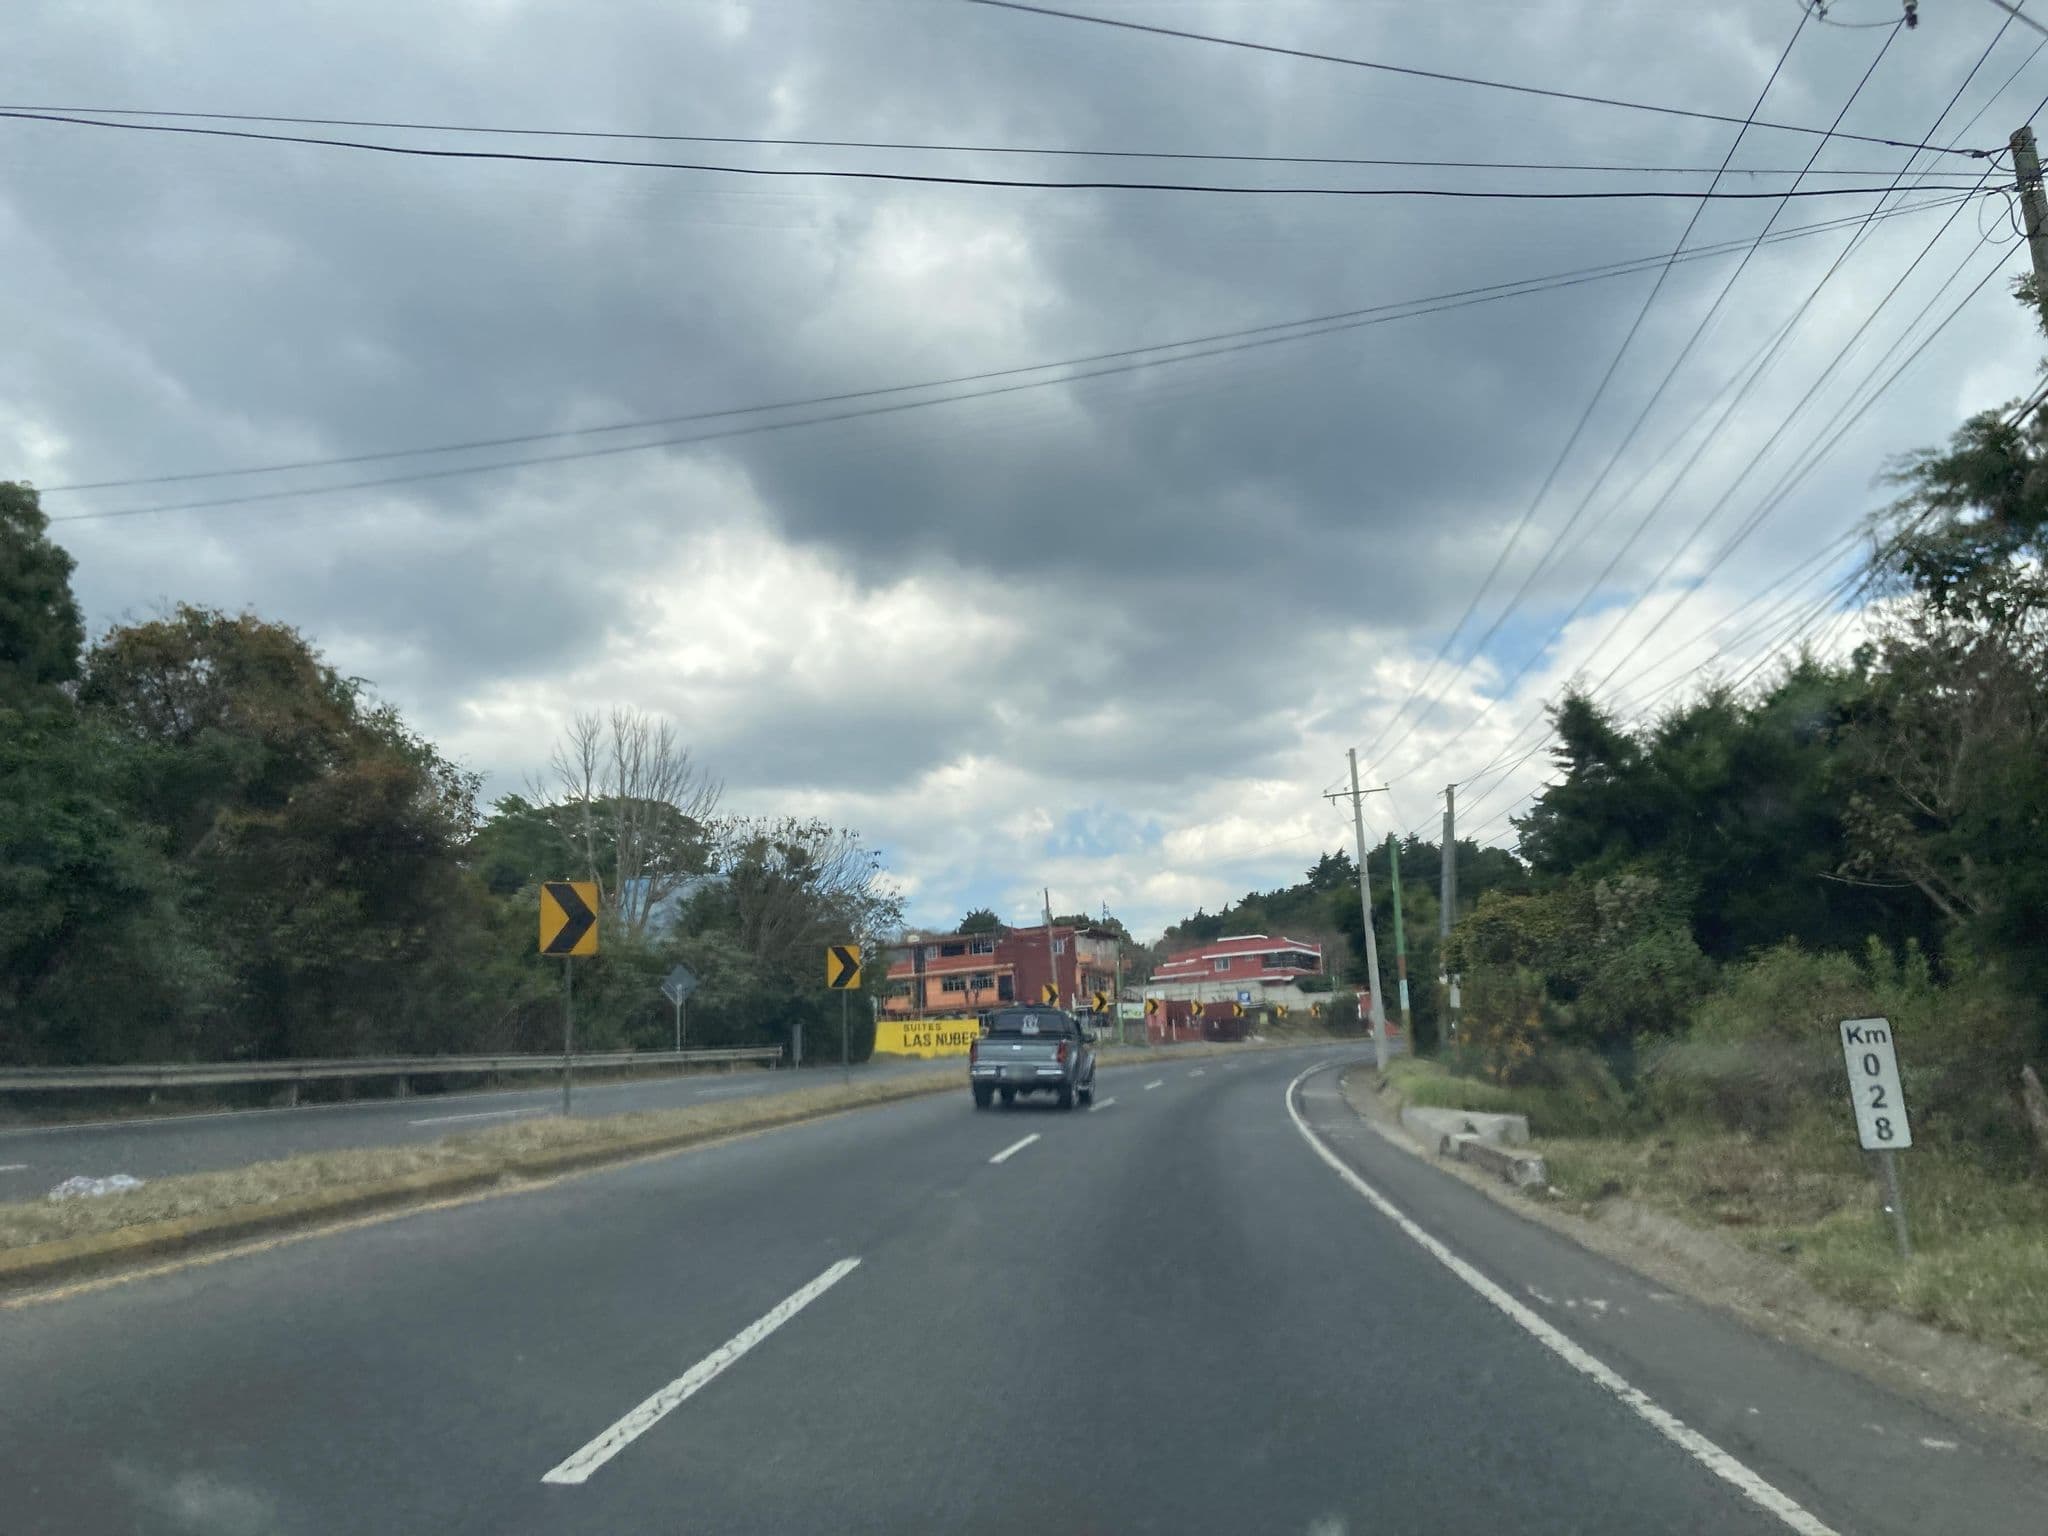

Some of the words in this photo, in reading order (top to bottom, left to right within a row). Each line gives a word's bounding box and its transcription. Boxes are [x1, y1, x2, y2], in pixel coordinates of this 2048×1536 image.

[903, 1022, 942, 1032] SUITES
[903, 1033, 931, 1047] LAS
[1846, 1026, 1887, 1045] Km
